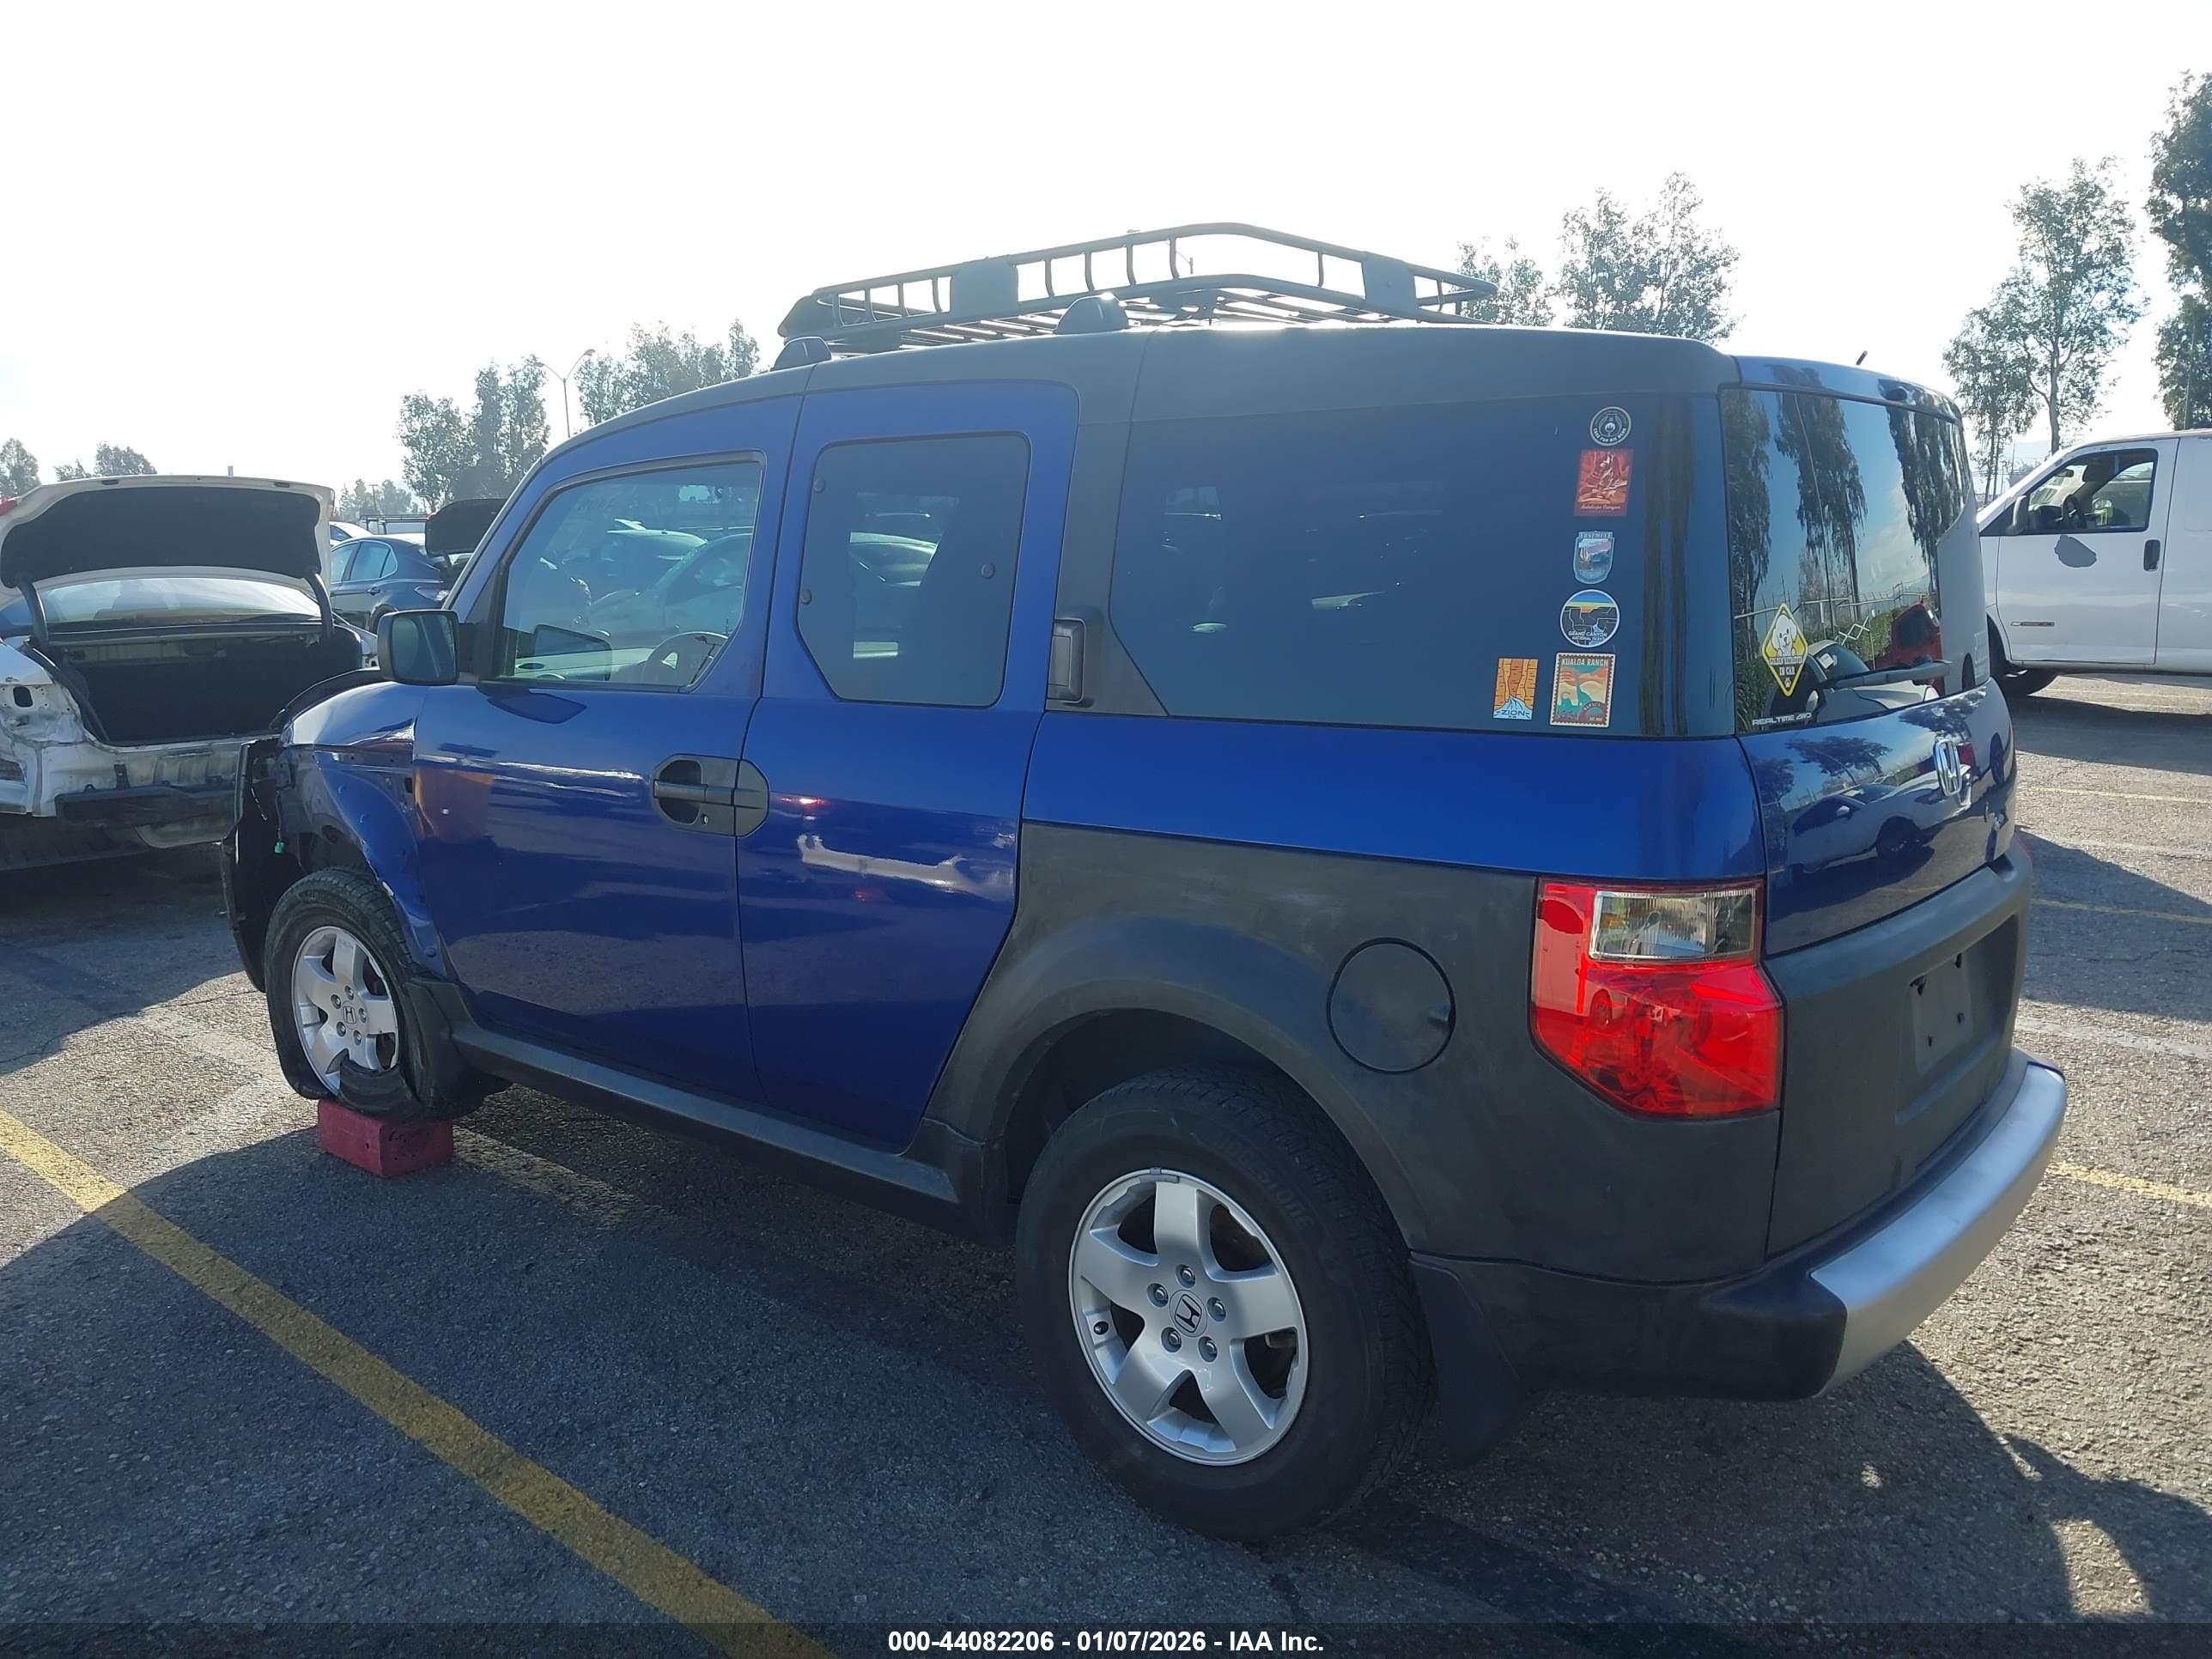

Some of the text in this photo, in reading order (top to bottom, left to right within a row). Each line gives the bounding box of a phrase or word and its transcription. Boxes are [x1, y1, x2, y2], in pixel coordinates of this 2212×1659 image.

[1562, 658, 1585, 666] KUALOA
[1785, 665, 1796, 676] CAR
[1752, 714, 1795, 726] REALTIME
